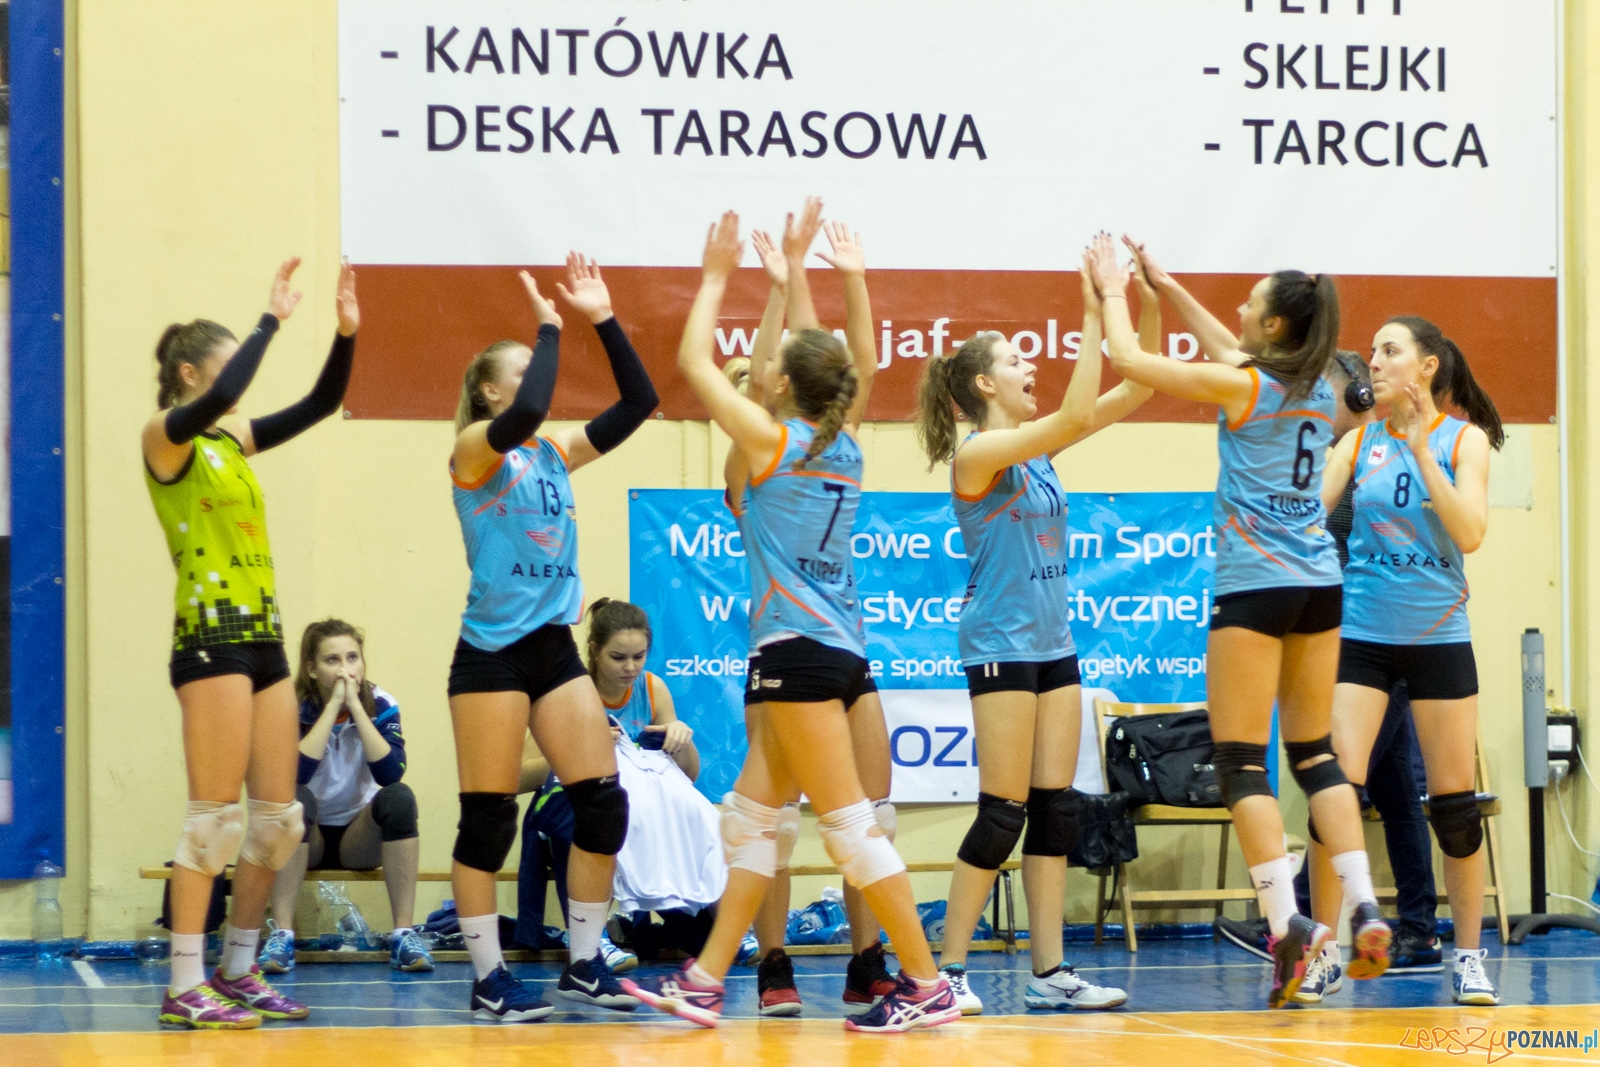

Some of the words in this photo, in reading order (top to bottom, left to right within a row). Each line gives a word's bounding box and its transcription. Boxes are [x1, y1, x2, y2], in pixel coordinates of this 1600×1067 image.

[425, 17, 794, 81] KANTÓWKA
[1242, 42, 1446, 92] SKLEJKI
[426, 104, 620, 155] DESKA
[640, 108, 987, 161] TARASOWA
[1242, 118, 1489, 169] TARCICA
[1292, 420, 1318, 491] 6
[537, 477, 562, 517] 13
[1038, 482, 1061, 517] 11
[1393, 472, 1411, 508] 8
[818, 482, 846, 552] 7
[1116, 525, 1217, 566] Sport
[1364, 553, 1450, 568] ALEXAS
[510, 563, 577, 578] ALEXA
[1030, 563, 1068, 581] ALEXA
[701, 596, 735, 622] w
[891, 655, 962, 681] sporto
[1156, 653, 1207, 680] wspi
